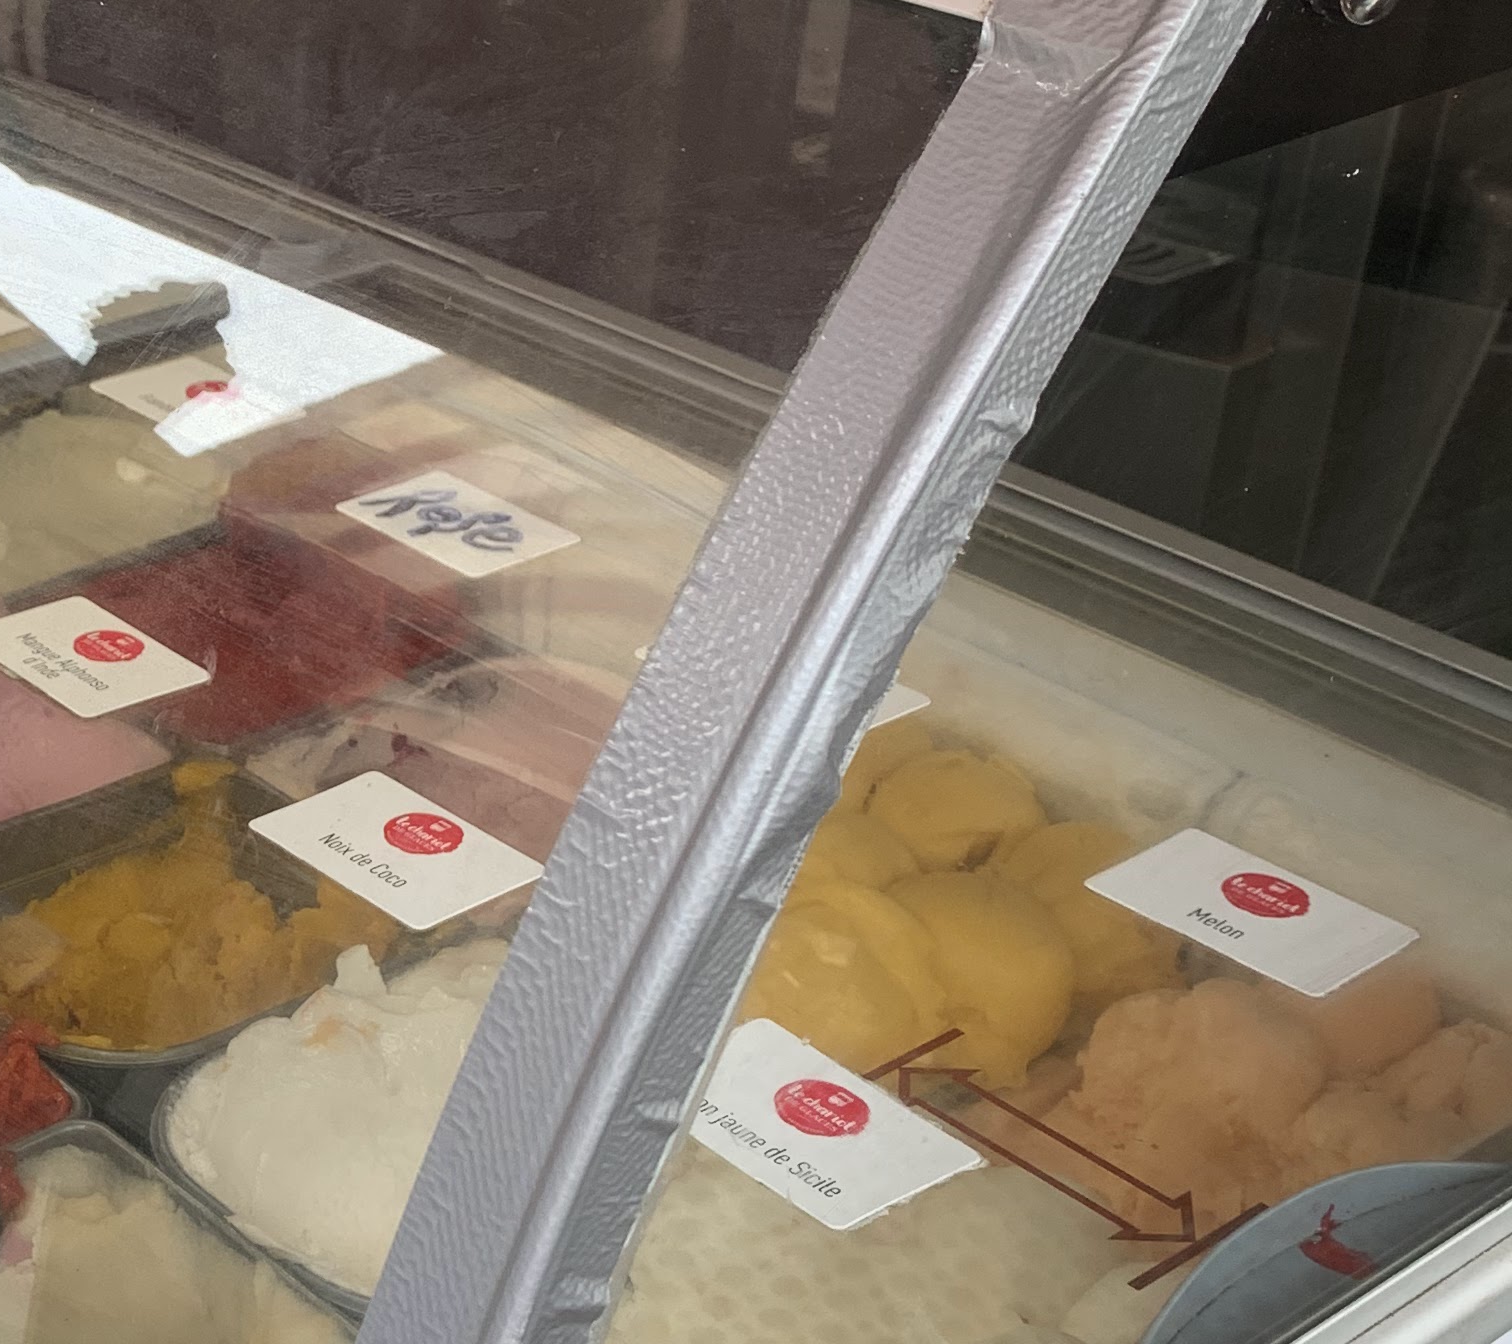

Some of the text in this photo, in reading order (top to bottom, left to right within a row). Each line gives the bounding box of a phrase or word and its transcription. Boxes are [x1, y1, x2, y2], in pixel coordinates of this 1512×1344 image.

[17, 632, 110, 692] Mangue Alphonso
[318, 832, 409, 891] Noix de Coco
[1186, 906, 1247, 943] Melon
[715, 1111, 843, 1200] jaune de Sicile
